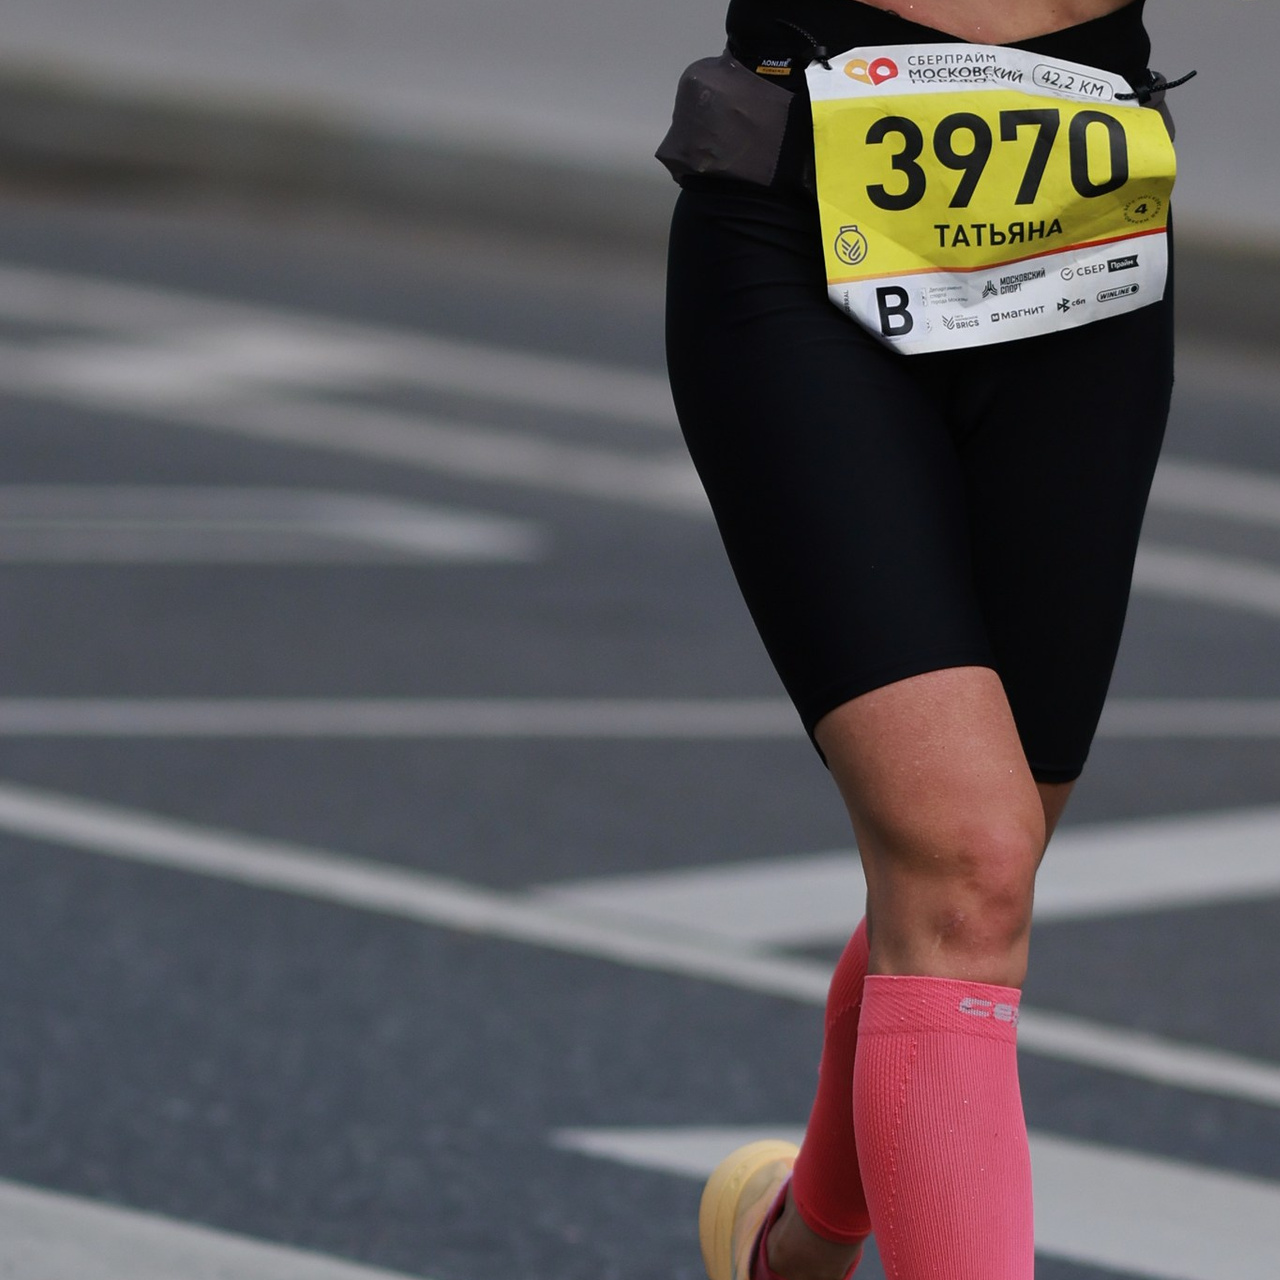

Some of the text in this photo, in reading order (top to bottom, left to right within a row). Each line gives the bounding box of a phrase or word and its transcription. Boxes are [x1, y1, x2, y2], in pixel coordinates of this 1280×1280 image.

[907, 52, 997, 66] СБЕРПРАЙМ
[908, 65, 1024, 84] МОСКОВСКИЙ
[1041, 70, 1075, 90] 42,2
[865, 108, 1129, 212] 3970
[934, 218, 1063, 248] ТАТЬЯНА
[1000, 267, 1046, 286] МОСКОВСКИЙ
[1076, 263, 1106, 276] СБЕР
[1000, 282, 1022, 295] СПОРТ
[1100, 287, 1130, 300] WINLINE
[1071, 298, 1086, 306] сбп
[876, 286, 914, 337] B
[956, 319, 980, 329] BRICS
